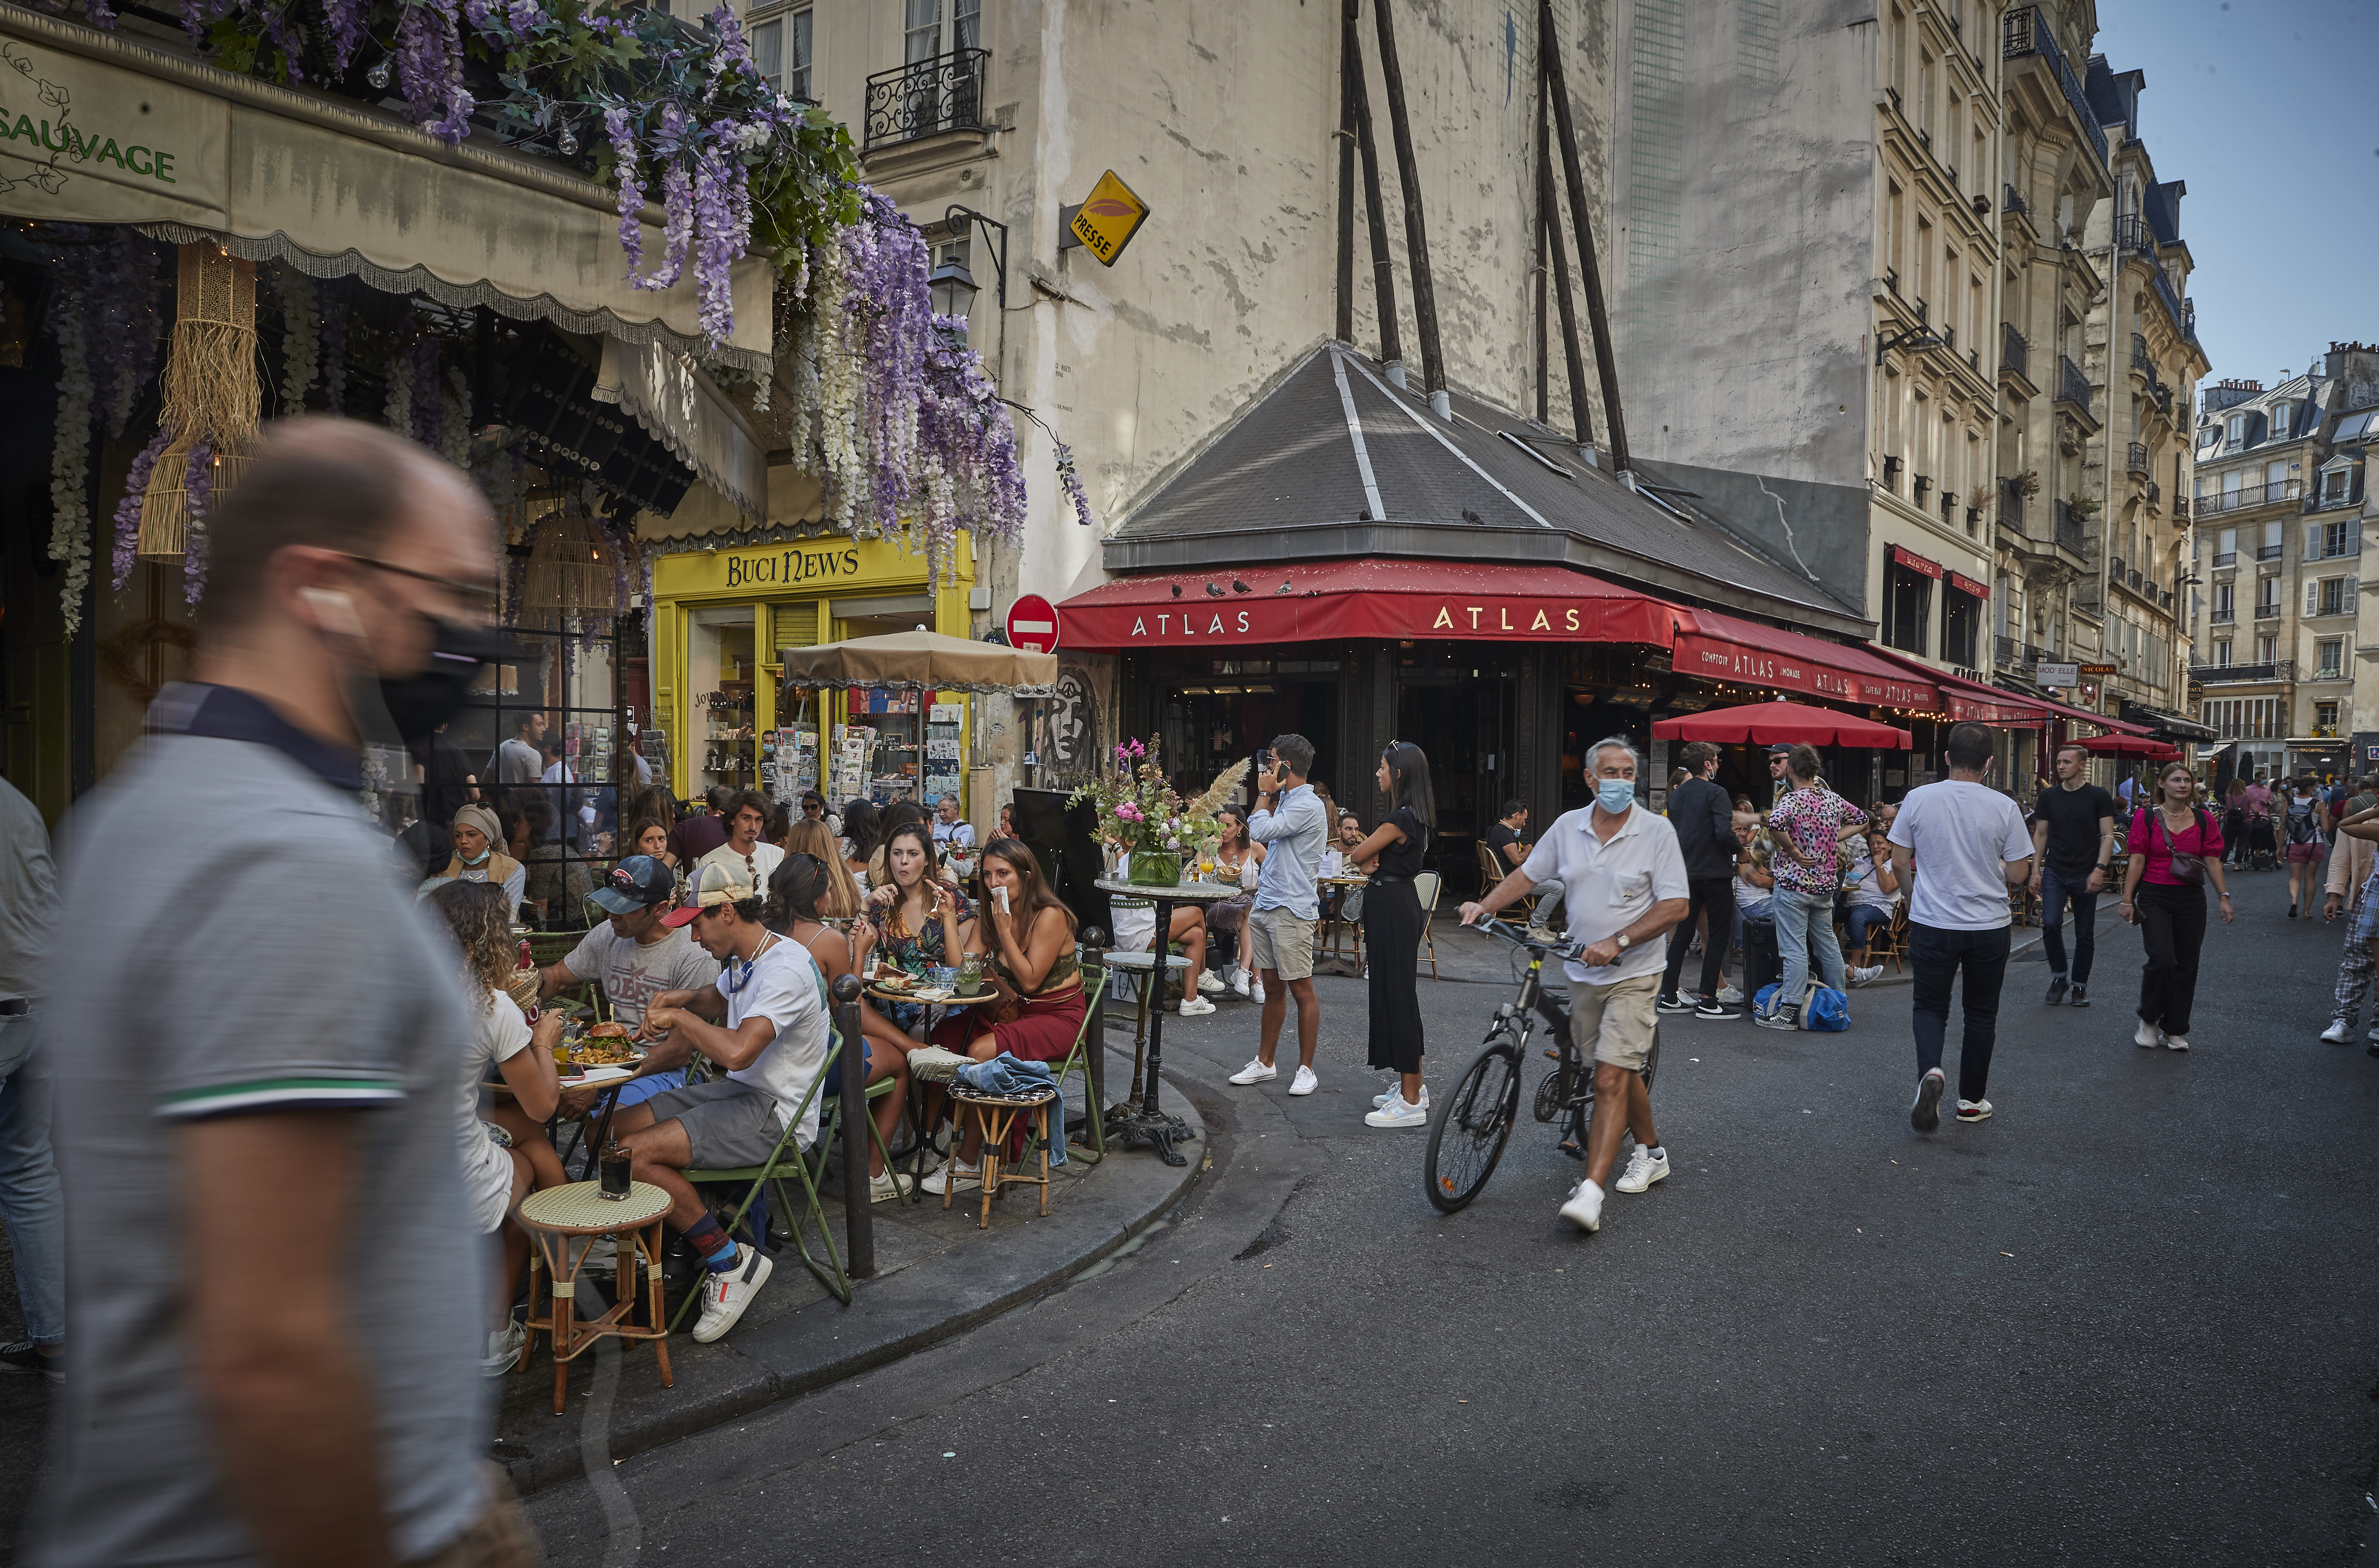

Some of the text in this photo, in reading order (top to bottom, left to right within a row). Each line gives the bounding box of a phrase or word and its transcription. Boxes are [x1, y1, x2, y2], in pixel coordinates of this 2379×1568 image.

[1075, 213, 1112, 256] PRESSE
[726, 549, 858, 587] BUCI NEWS
[1131, 611, 1251, 637] ATLAS
[1433, 606, 1580, 632] ATLAS
[1702, 651, 1728, 666] COMPTOIR
[1735, 654, 1773, 678] ATLAS
[1817, 674, 1848, 694] ATLAS
[1885, 686, 1911, 703] ATLAS
[1966, 706, 1984, 720] ATLAS
